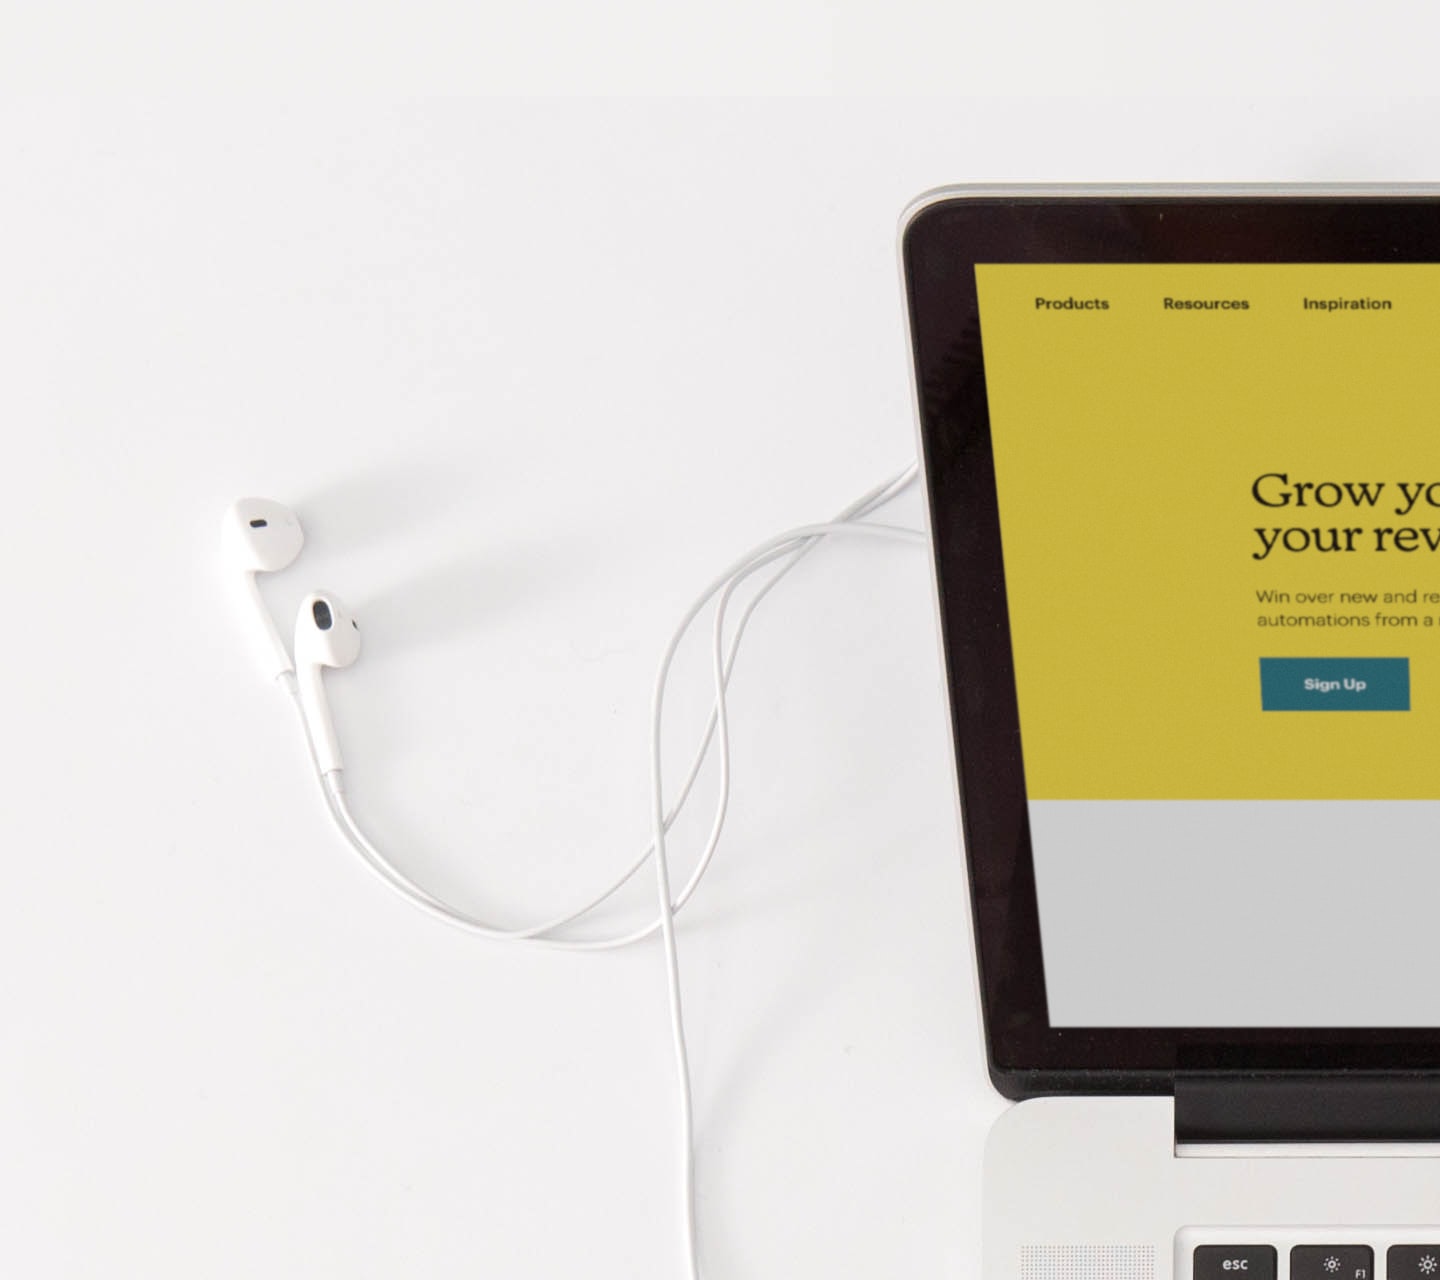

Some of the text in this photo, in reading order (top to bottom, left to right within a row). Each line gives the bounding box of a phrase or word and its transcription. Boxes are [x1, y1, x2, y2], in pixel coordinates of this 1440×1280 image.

[1034, 296, 1110, 311] Products
[1162, 296, 1251, 311] Resources
[1303, 296, 1393, 313] Inspiration
[1251, 472, 1386, 508] Grow
[1251, 527, 1364, 561] your
[1255, 589, 1291, 604] Win
[1295, 592, 1335, 604] over
[1339, 592, 1379, 604] new
[1383, 588, 1418, 604] and
[1256, 612, 1371, 628] automations
[1374, 611, 1419, 628] from
[1422, 615, 1434, 628] a
[1303, 677, 1367, 693] Sign Up
[1222, 1259, 1249, 1272] esc
[1355, 1268, 1366, 1280] F1
